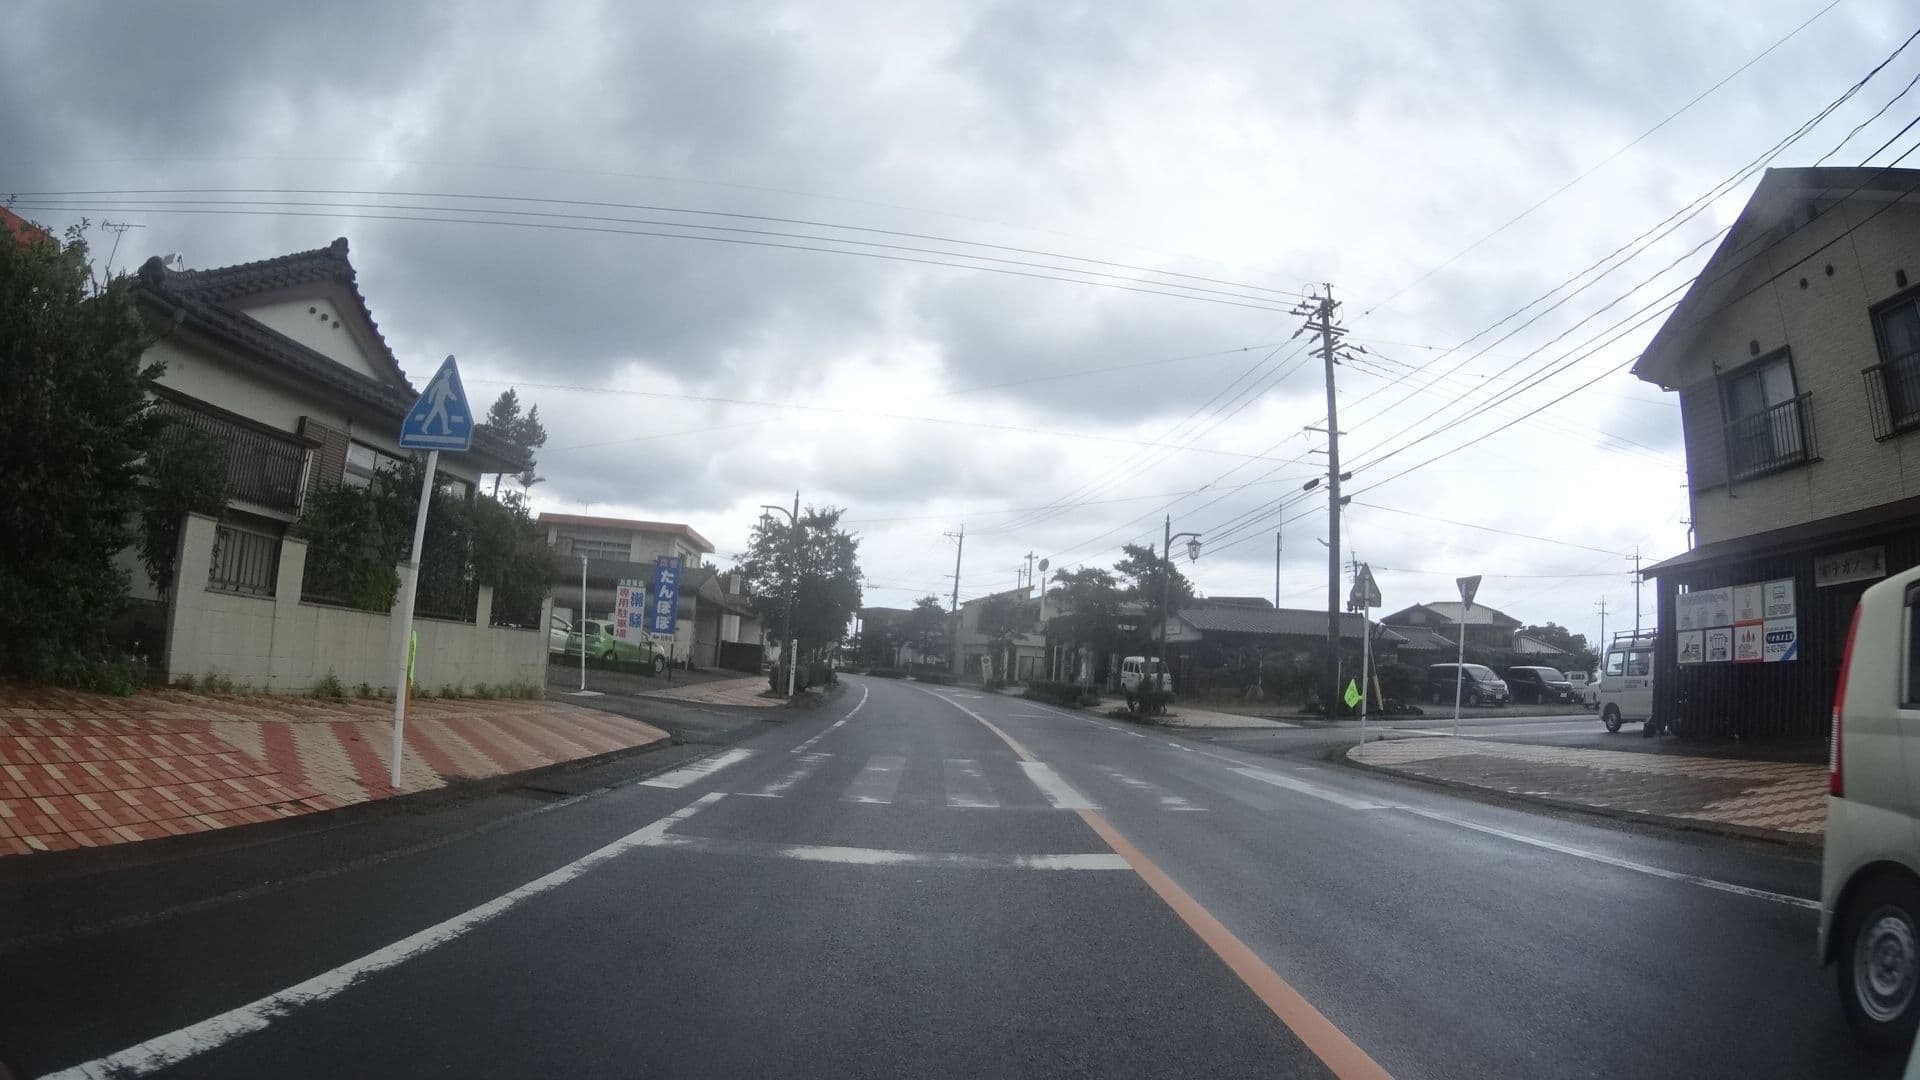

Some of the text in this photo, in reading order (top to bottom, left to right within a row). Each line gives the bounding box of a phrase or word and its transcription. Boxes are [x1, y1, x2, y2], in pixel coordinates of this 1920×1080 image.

[616, 588, 629, 638] 専用駐車場
